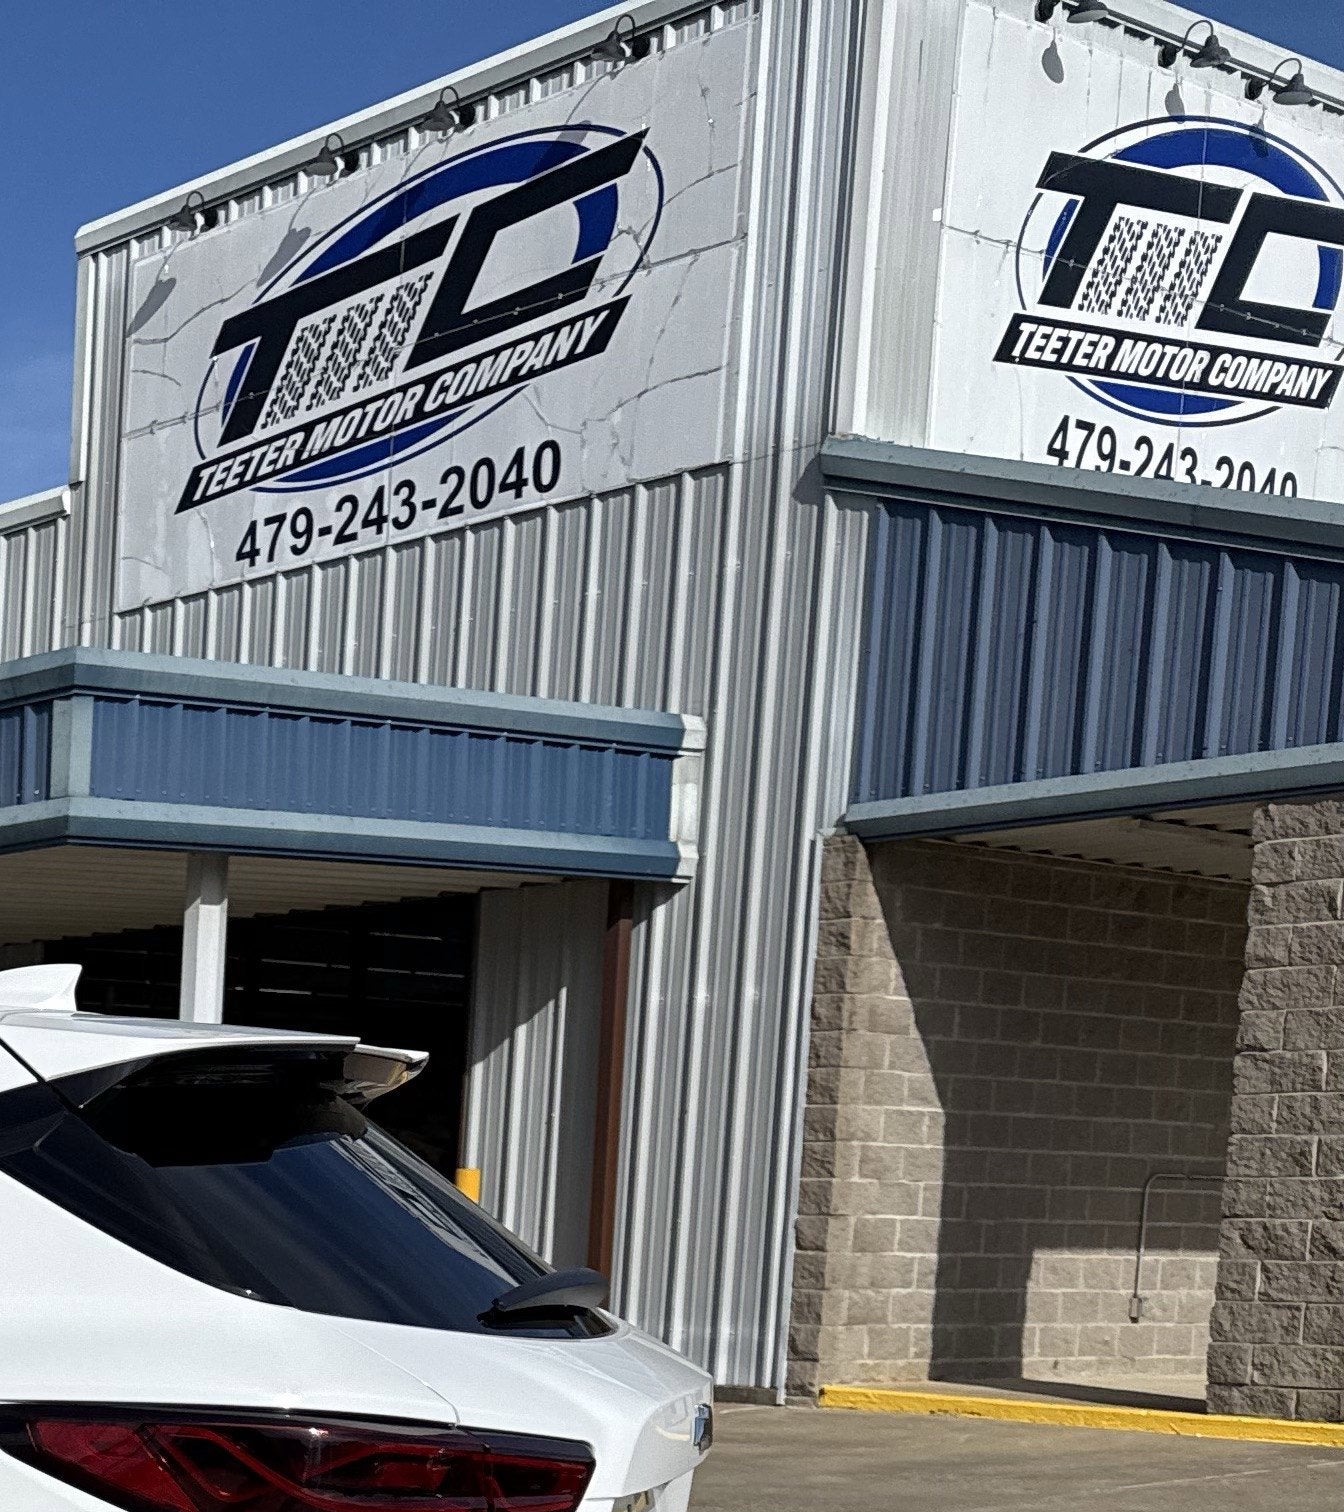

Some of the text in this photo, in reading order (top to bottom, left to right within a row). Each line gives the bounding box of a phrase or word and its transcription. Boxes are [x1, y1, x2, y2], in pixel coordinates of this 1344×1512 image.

[192, 309, 610, 501] TEETER MOTOR COMPANY
[1011, 322, 1333, 401] TEETER MOTOR COMPANY
[235, 439, 562, 568] 479-243-2040
